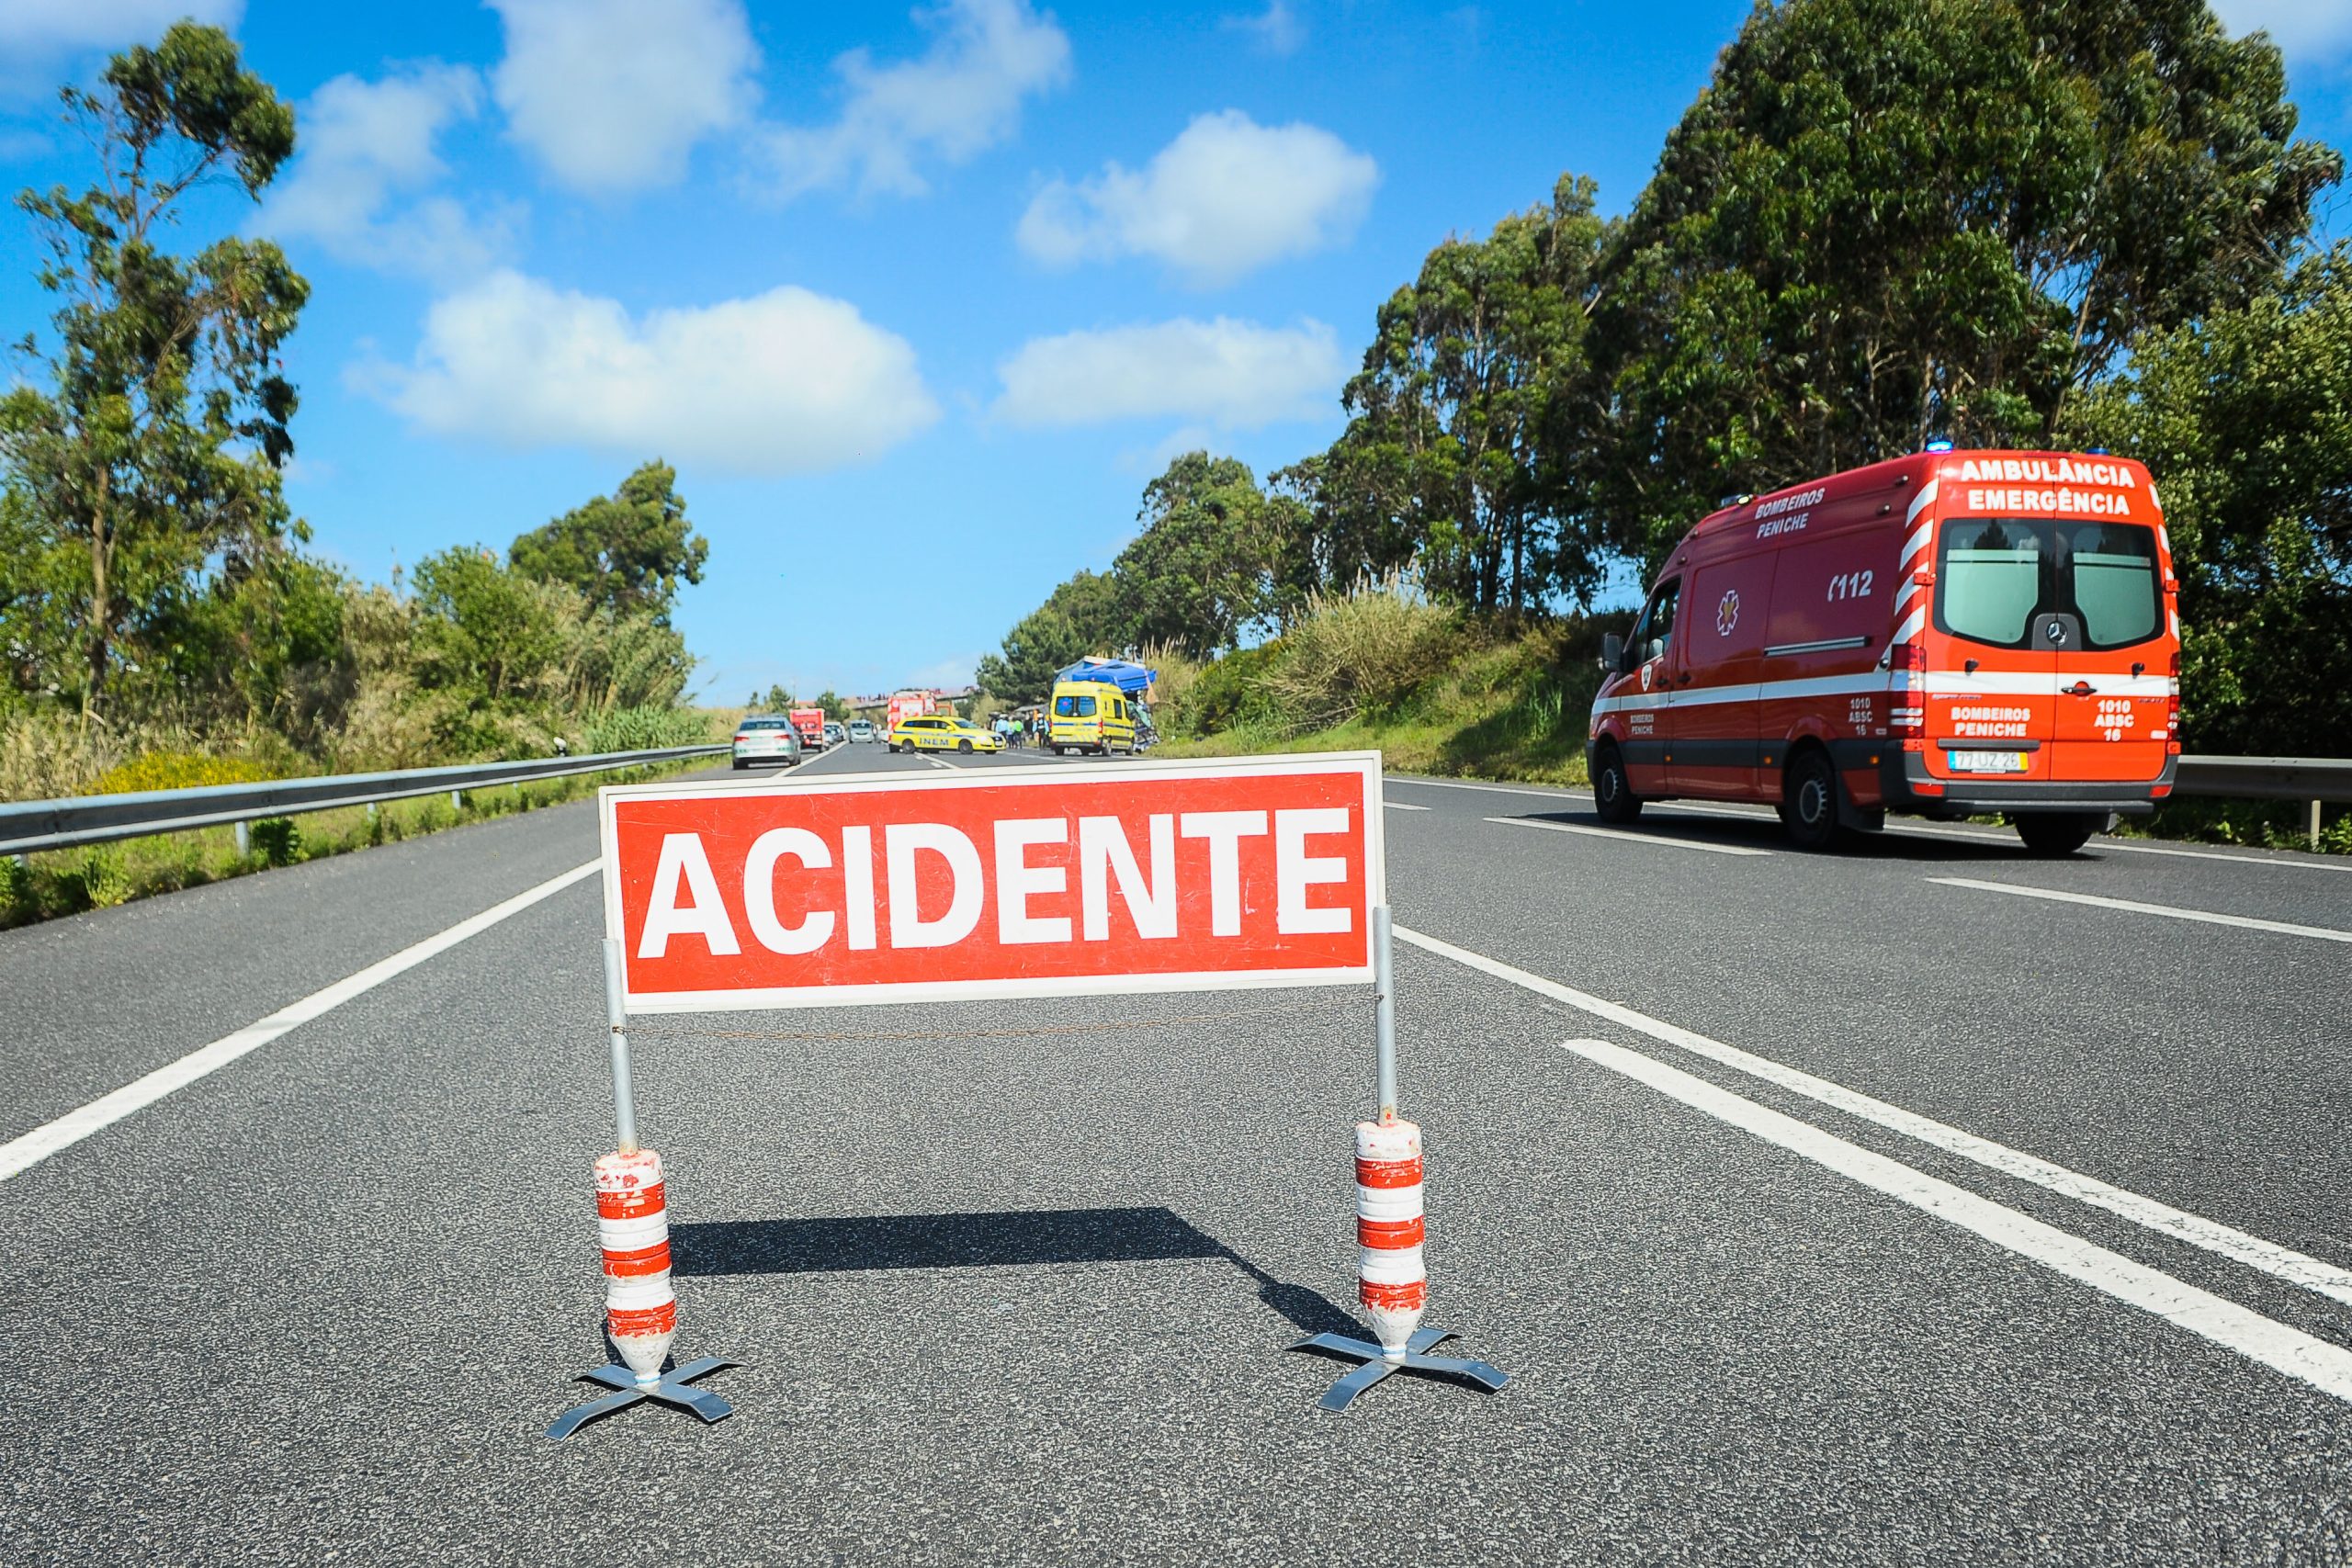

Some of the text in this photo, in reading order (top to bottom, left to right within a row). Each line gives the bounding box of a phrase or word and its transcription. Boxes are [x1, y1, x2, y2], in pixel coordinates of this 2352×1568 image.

[1961, 457, 2135, 488] AMBULÂNCIA
[1755, 487, 1826, 520] BOMBEIROS
[1968, 488, 2131, 514] EMERGÊNCIA
[1757, 513, 1809, 539] PENICHE
[1838, 570, 1873, 600] 112
[1850, 697, 1871, 709] 1010
[2097, 699, 2131, 713] 1010
[1849, 711, 1872, 723] ABSC
[1951, 706, 2030, 721] BOMBEIROS
[2094, 714, 2134, 728] ABSC
[1954, 722, 2027, 737] PENICHE
[2104, 728, 2121, 741] 16
[920, 737, 949, 746] INEM
[637, 807, 1352, 959] ACIDENTE
